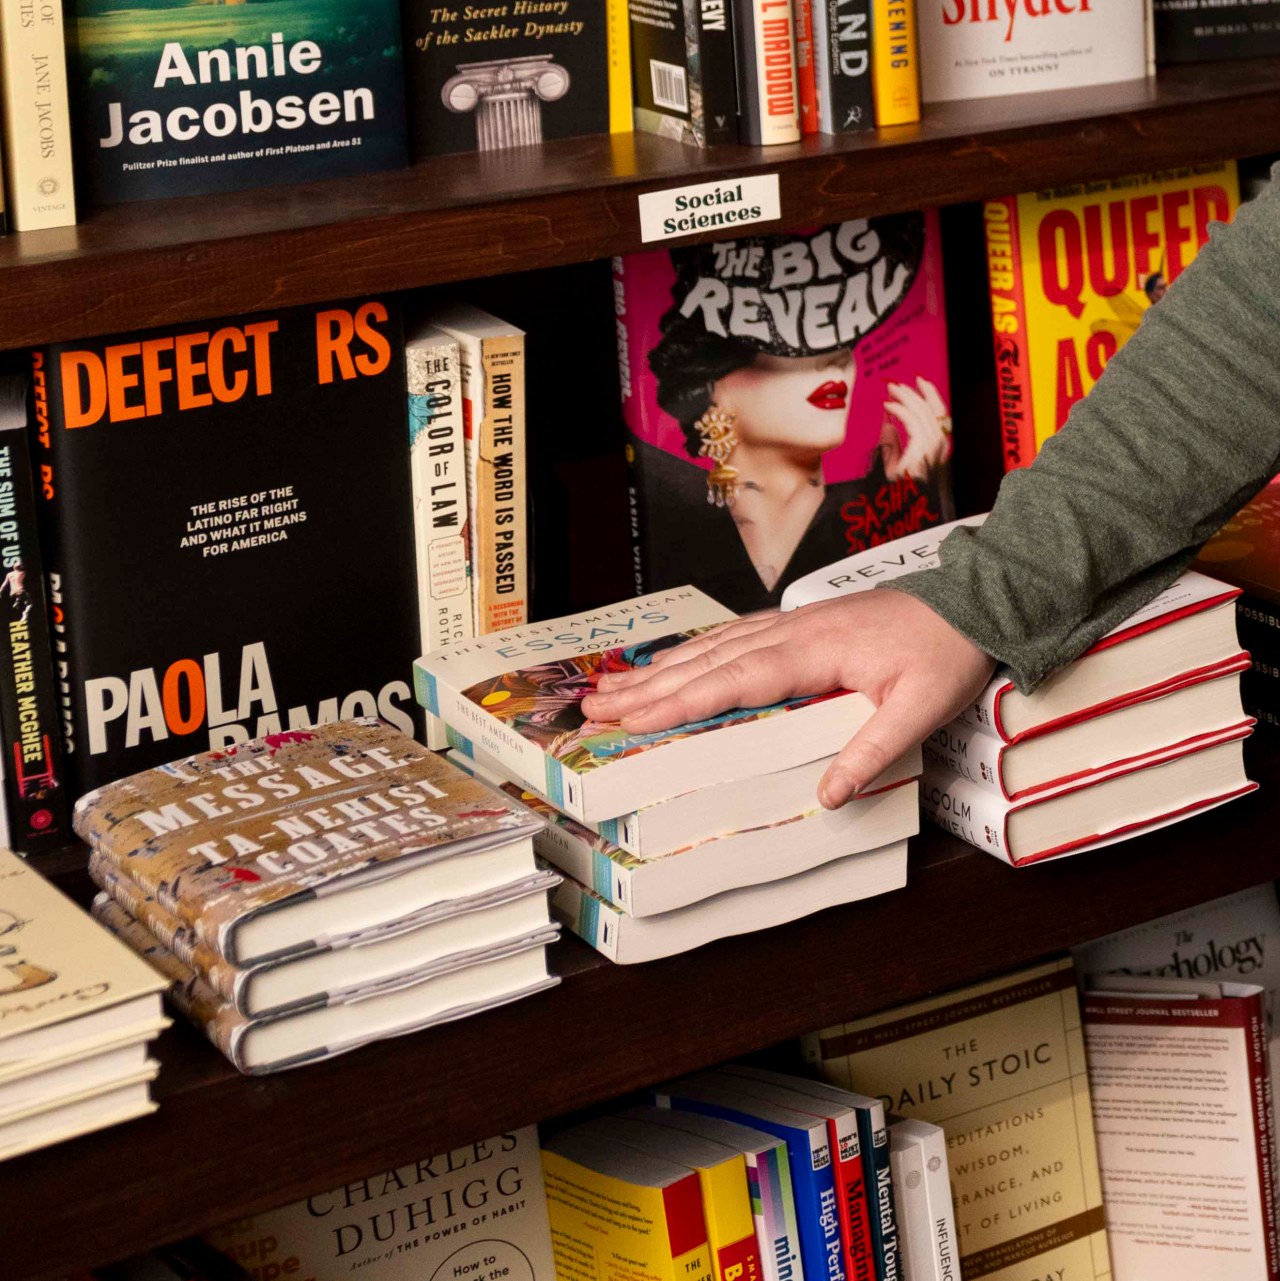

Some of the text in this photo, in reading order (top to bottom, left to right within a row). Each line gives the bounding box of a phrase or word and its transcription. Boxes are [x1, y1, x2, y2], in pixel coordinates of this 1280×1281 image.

[430, 7, 458, 24] The
[463, 3, 509, 20] Secret
[152, 32, 322, 88] Annie
[762, 17, 795, 117] MADDOW
[100, 87, 375, 149] Jacobsen
[663, 203, 762, 235] Sciences
[675, 185, 744, 212] Social
[715, 220, 882, 289] THE BIG
[681, 263, 908, 350] REVEAL
[60, 320, 278, 429] DEFECT
[190, 486, 293, 516] THE RISE OF THE
[491, 372, 515, 595] HOW THE WORD IS PASSED
[187, 499, 299, 531] LATINO FAR RIGHT
[497, 610, 671, 659] ESSAYS
[574, 637, 626, 654] 2024
[85, 641, 278, 756] PAOLA
[133, 746, 403, 838] MESSAGE
[211, 753, 287, 783] THE
[187, 778, 451, 867] TA-NEHISI
[255, 805, 448, 877] COATES
[943, 1038, 980, 1060] THE
[968, 1044, 1052, 1088] STOIC
[332, 1166, 525, 1259] DUHIGG
